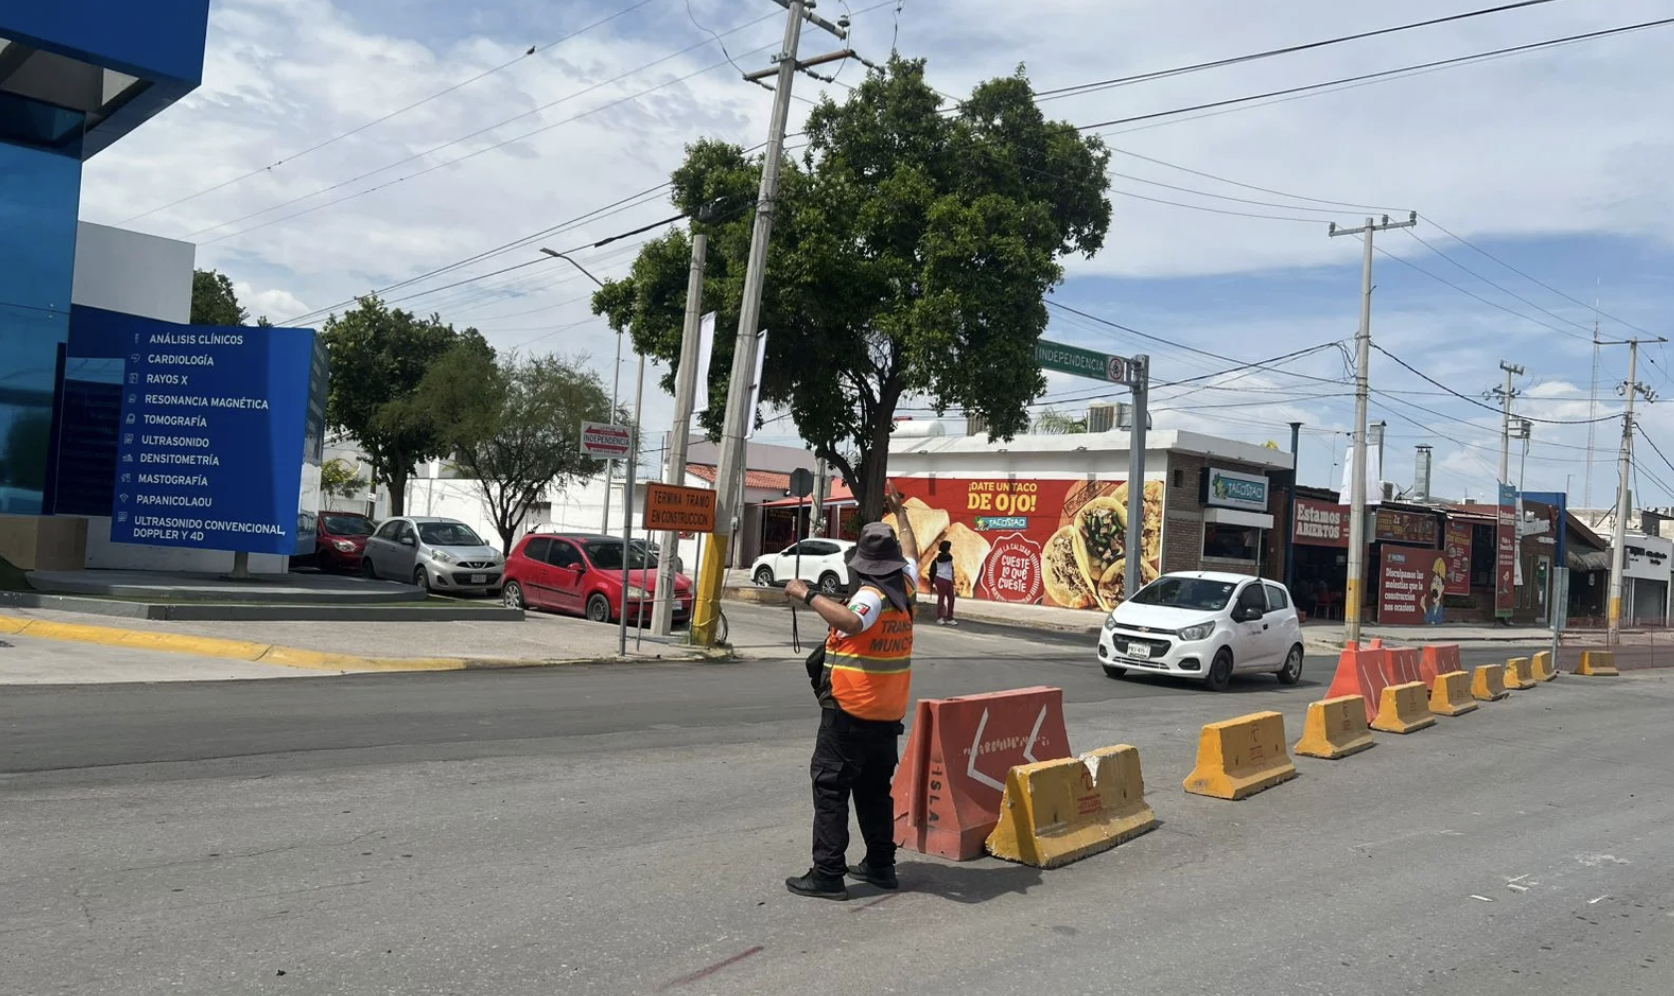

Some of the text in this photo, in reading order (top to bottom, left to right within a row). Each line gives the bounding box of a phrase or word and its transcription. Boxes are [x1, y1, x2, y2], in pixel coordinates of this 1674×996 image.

[149, 332, 244, 345] ANÁLISIS CLÍNICOS
[147, 354, 214, 366] CARDIOLOGÍA
[1039, 347, 1105, 372] INDEPENDENCIA
[146, 374, 188, 385] RAYOS X
[145, 394, 269, 410] RESONANCIA MAGNÉTICA
[143, 414, 207, 427] TOMOGRAFÍA
[141, 435, 209, 448] ULTRASONIDO
[584, 434, 630, 446] INDEPENDENCIA
[140, 453, 220, 466] DENSITOMETRÍA
[138, 474, 208, 486] MASTOGRAFÍA
[996, 482, 1010, 491] UN
[1011, 482, 1038, 492] TACO
[136, 494, 212, 507] PAPANICOLAOU
[654, 490, 710, 508] TERMINA TRAMO
[967, 492, 1037, 516] DE OJO!
[652, 509, 660, 523] EN
[1296, 503, 1340, 524] Estamos
[134, 516, 286, 536] ULTRASONIDO CONVENCIONAL,
[1296, 521, 1340, 538] ABIERTOS
[133, 528, 204, 541] DOPPLER Y 4D
[1001, 555, 1030, 570] CUESTE
[1011, 567, 1027, 580] QUE
[997, 577, 1026, 593] CUESTE
